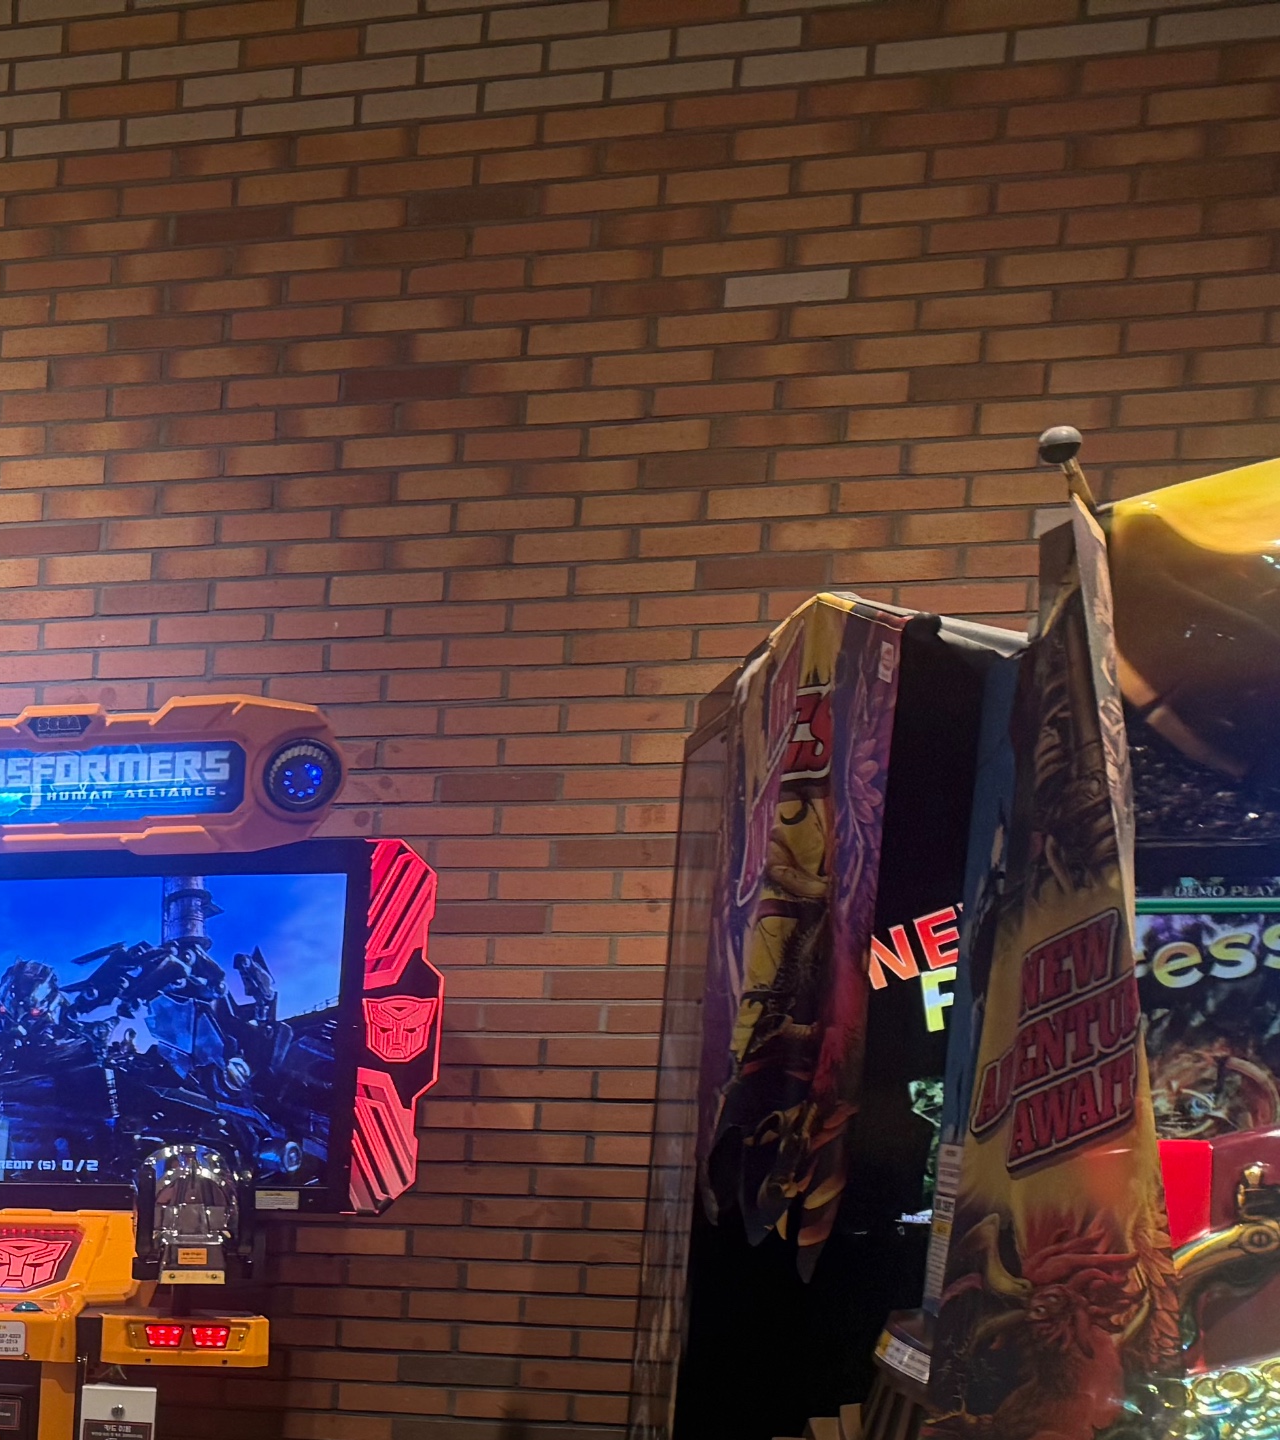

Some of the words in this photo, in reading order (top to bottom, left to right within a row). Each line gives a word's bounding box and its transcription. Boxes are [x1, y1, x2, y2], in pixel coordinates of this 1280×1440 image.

[47, 789, 113, 801] HUMAN
[125, 786, 217, 799] ALLIANCE
[1174, 885, 1225, 898] DEMO
[1230, 884, 1276, 898] PLAY
[869, 903, 964, 990] NE
[61, 1159, 100, 1172] 0/2
